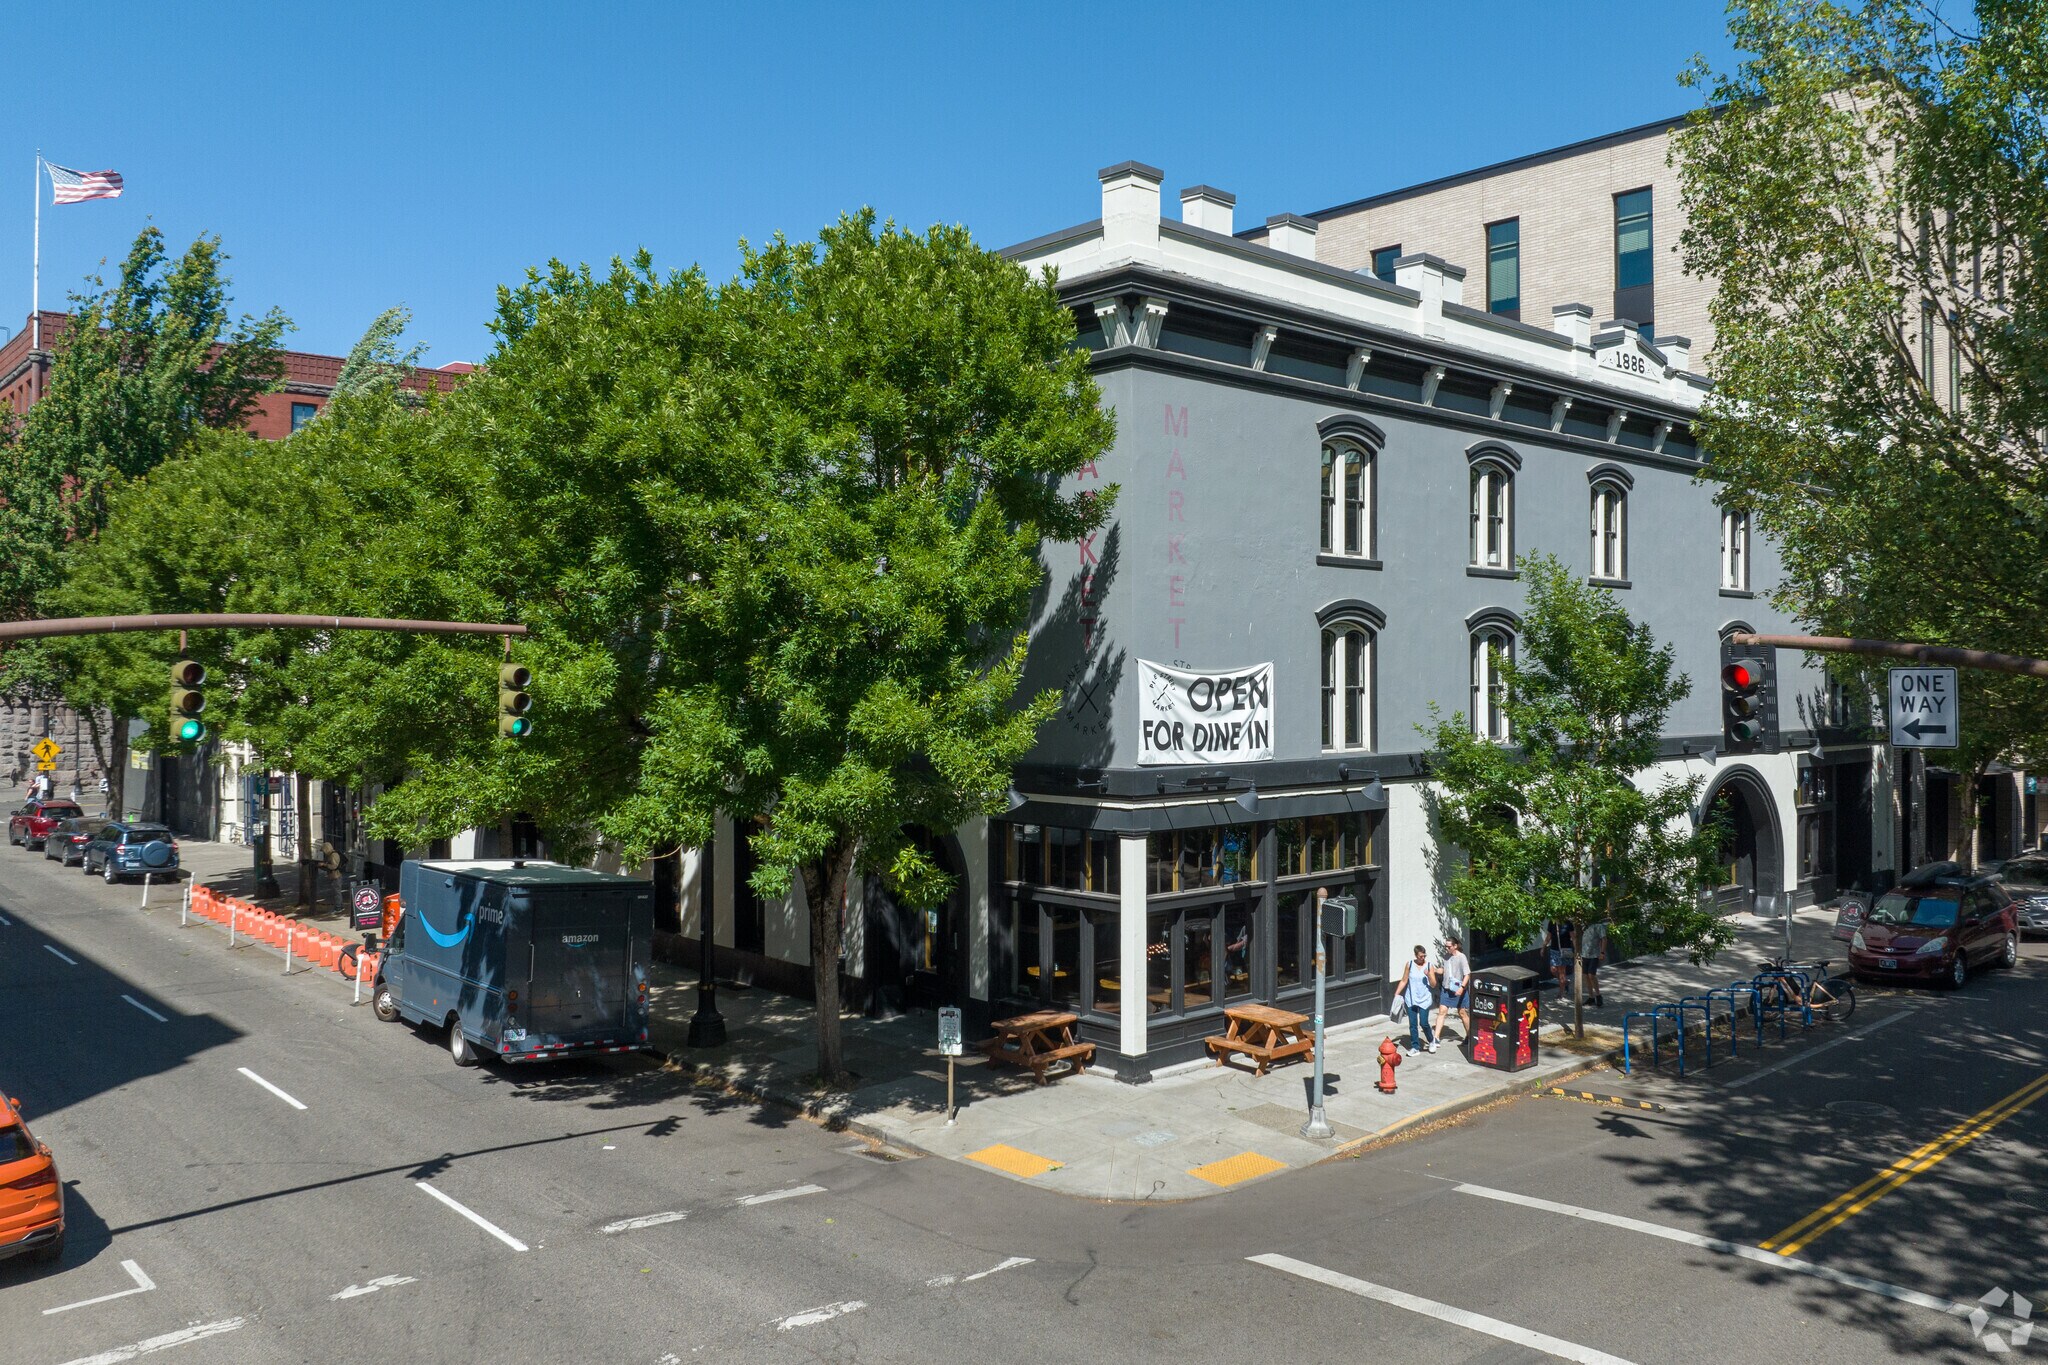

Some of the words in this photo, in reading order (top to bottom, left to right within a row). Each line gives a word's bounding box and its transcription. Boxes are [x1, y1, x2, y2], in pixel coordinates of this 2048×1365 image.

[1616, 351, 1645, 374] 1886
[1164, 404, 1188, 649] MARKET
[1078, 456, 1098, 653] AKET
[1063, 664, 1081, 693] PINE
[1085, 660, 1116, 697] STREET
[1149, 673, 1157, 689] PIE
[1901, 675, 1945, 692] ONE
[1187, 673, 1269, 712] OPEN
[1900, 696, 1946, 713] WAY
[1066, 711, 1110, 735] MARKET
[1143, 720, 1184, 751] FOR
[1192, 722, 1242, 752] DINE
[1248, 720, 1269, 749] IN
[478, 902, 503, 925] prime
[561, 934, 599, 944] amazon
